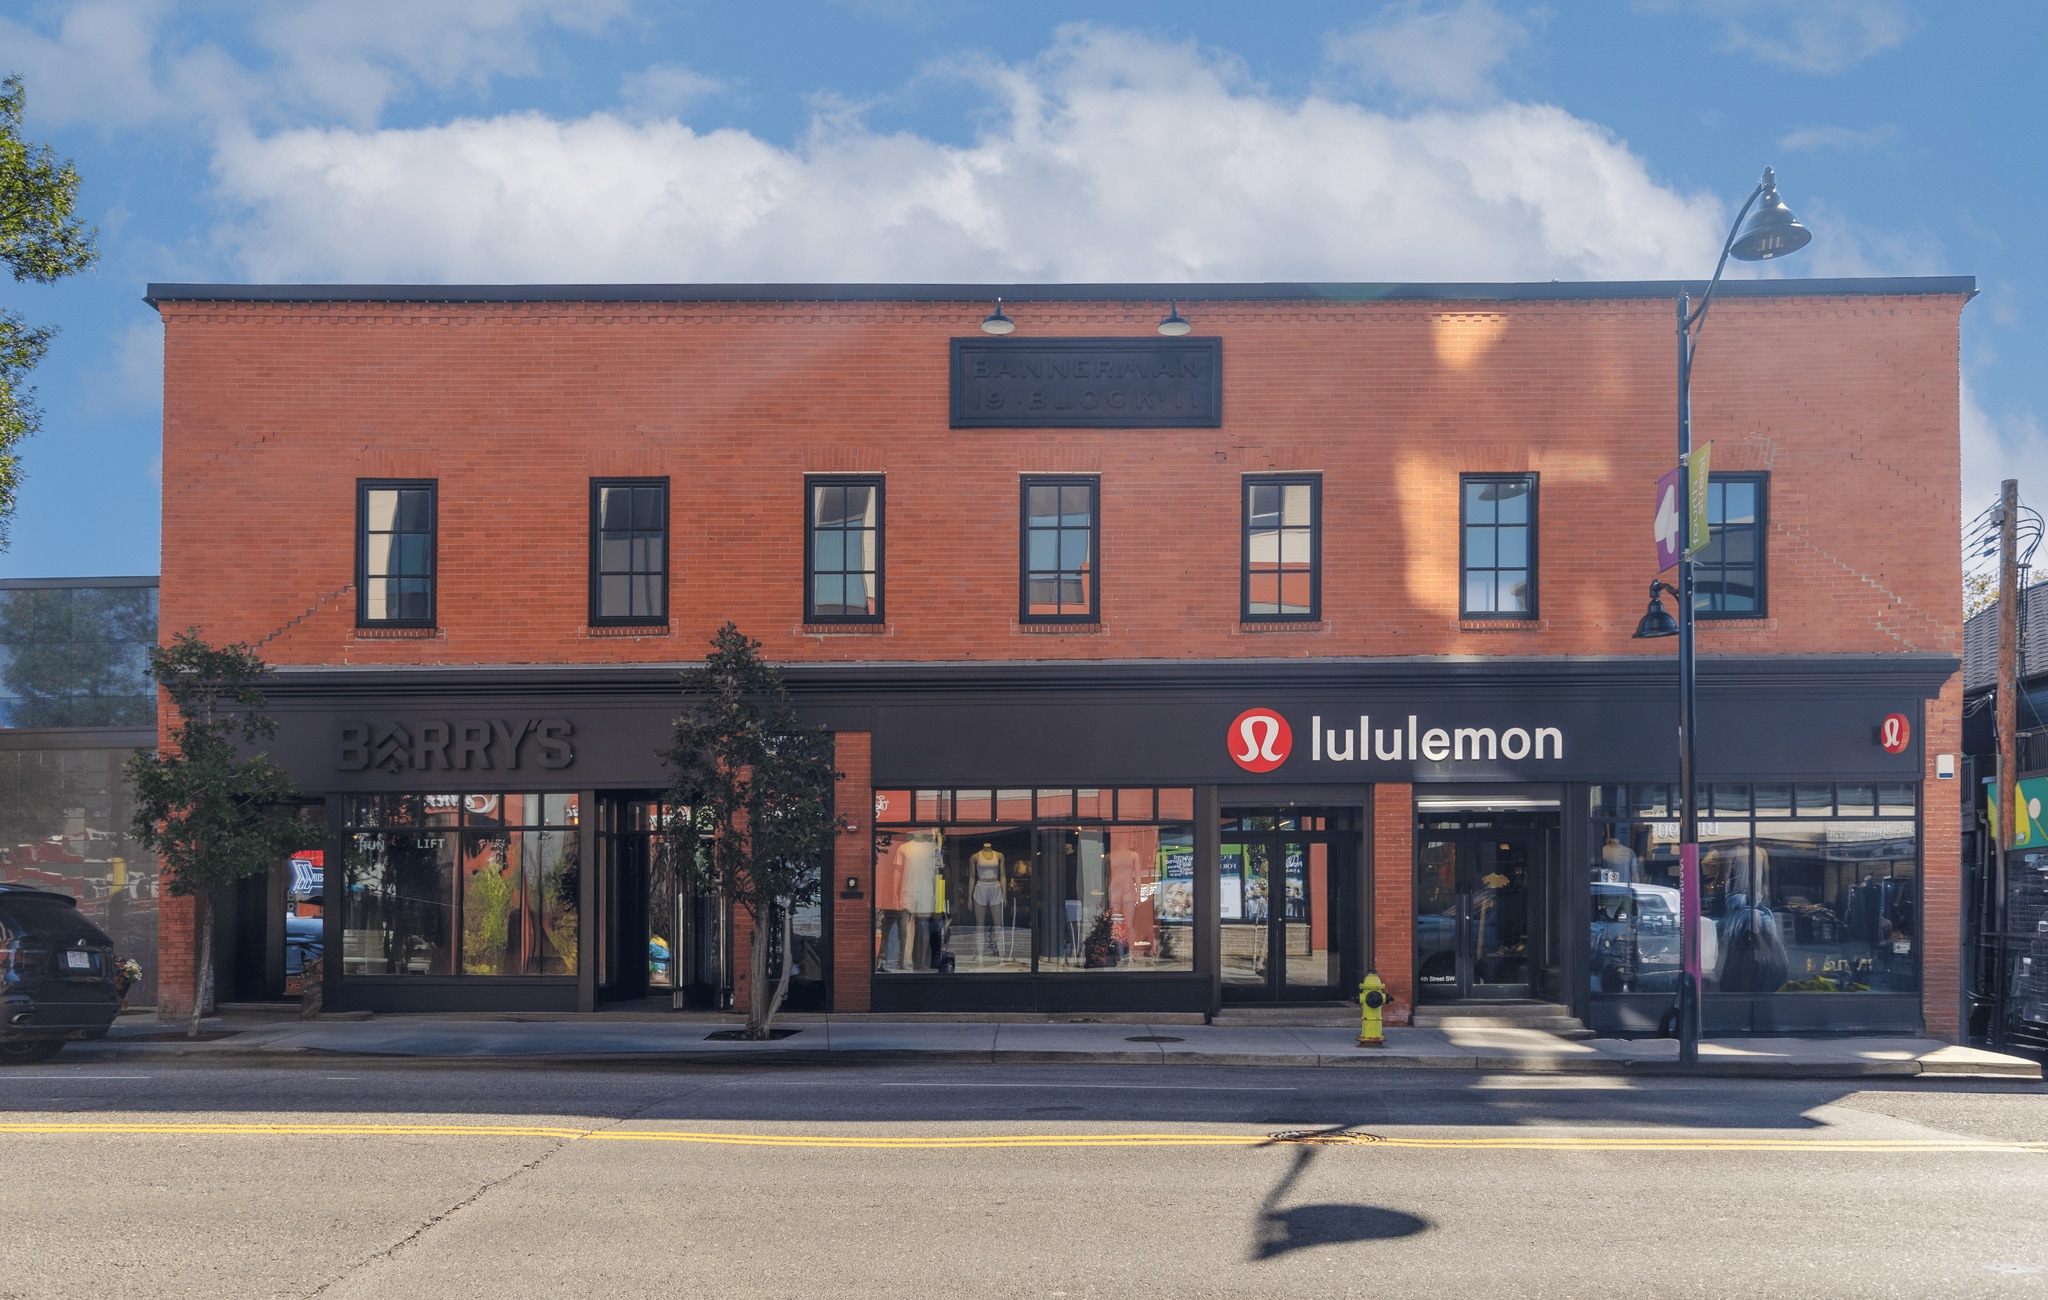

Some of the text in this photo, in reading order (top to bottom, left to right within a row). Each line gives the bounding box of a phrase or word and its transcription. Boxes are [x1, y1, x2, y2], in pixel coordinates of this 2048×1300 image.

[973, 360, 1200, 379] BANNERMAN
[973, 389, 1005, 410] 19
[1028, 389, 1154, 410] BLOCK
[1698, 453, 1706, 515] street
[1691, 480, 1699, 545] fourth
[1312, 715, 1563, 761] lululemon
[359, 839, 445, 850] RUN LIFT
